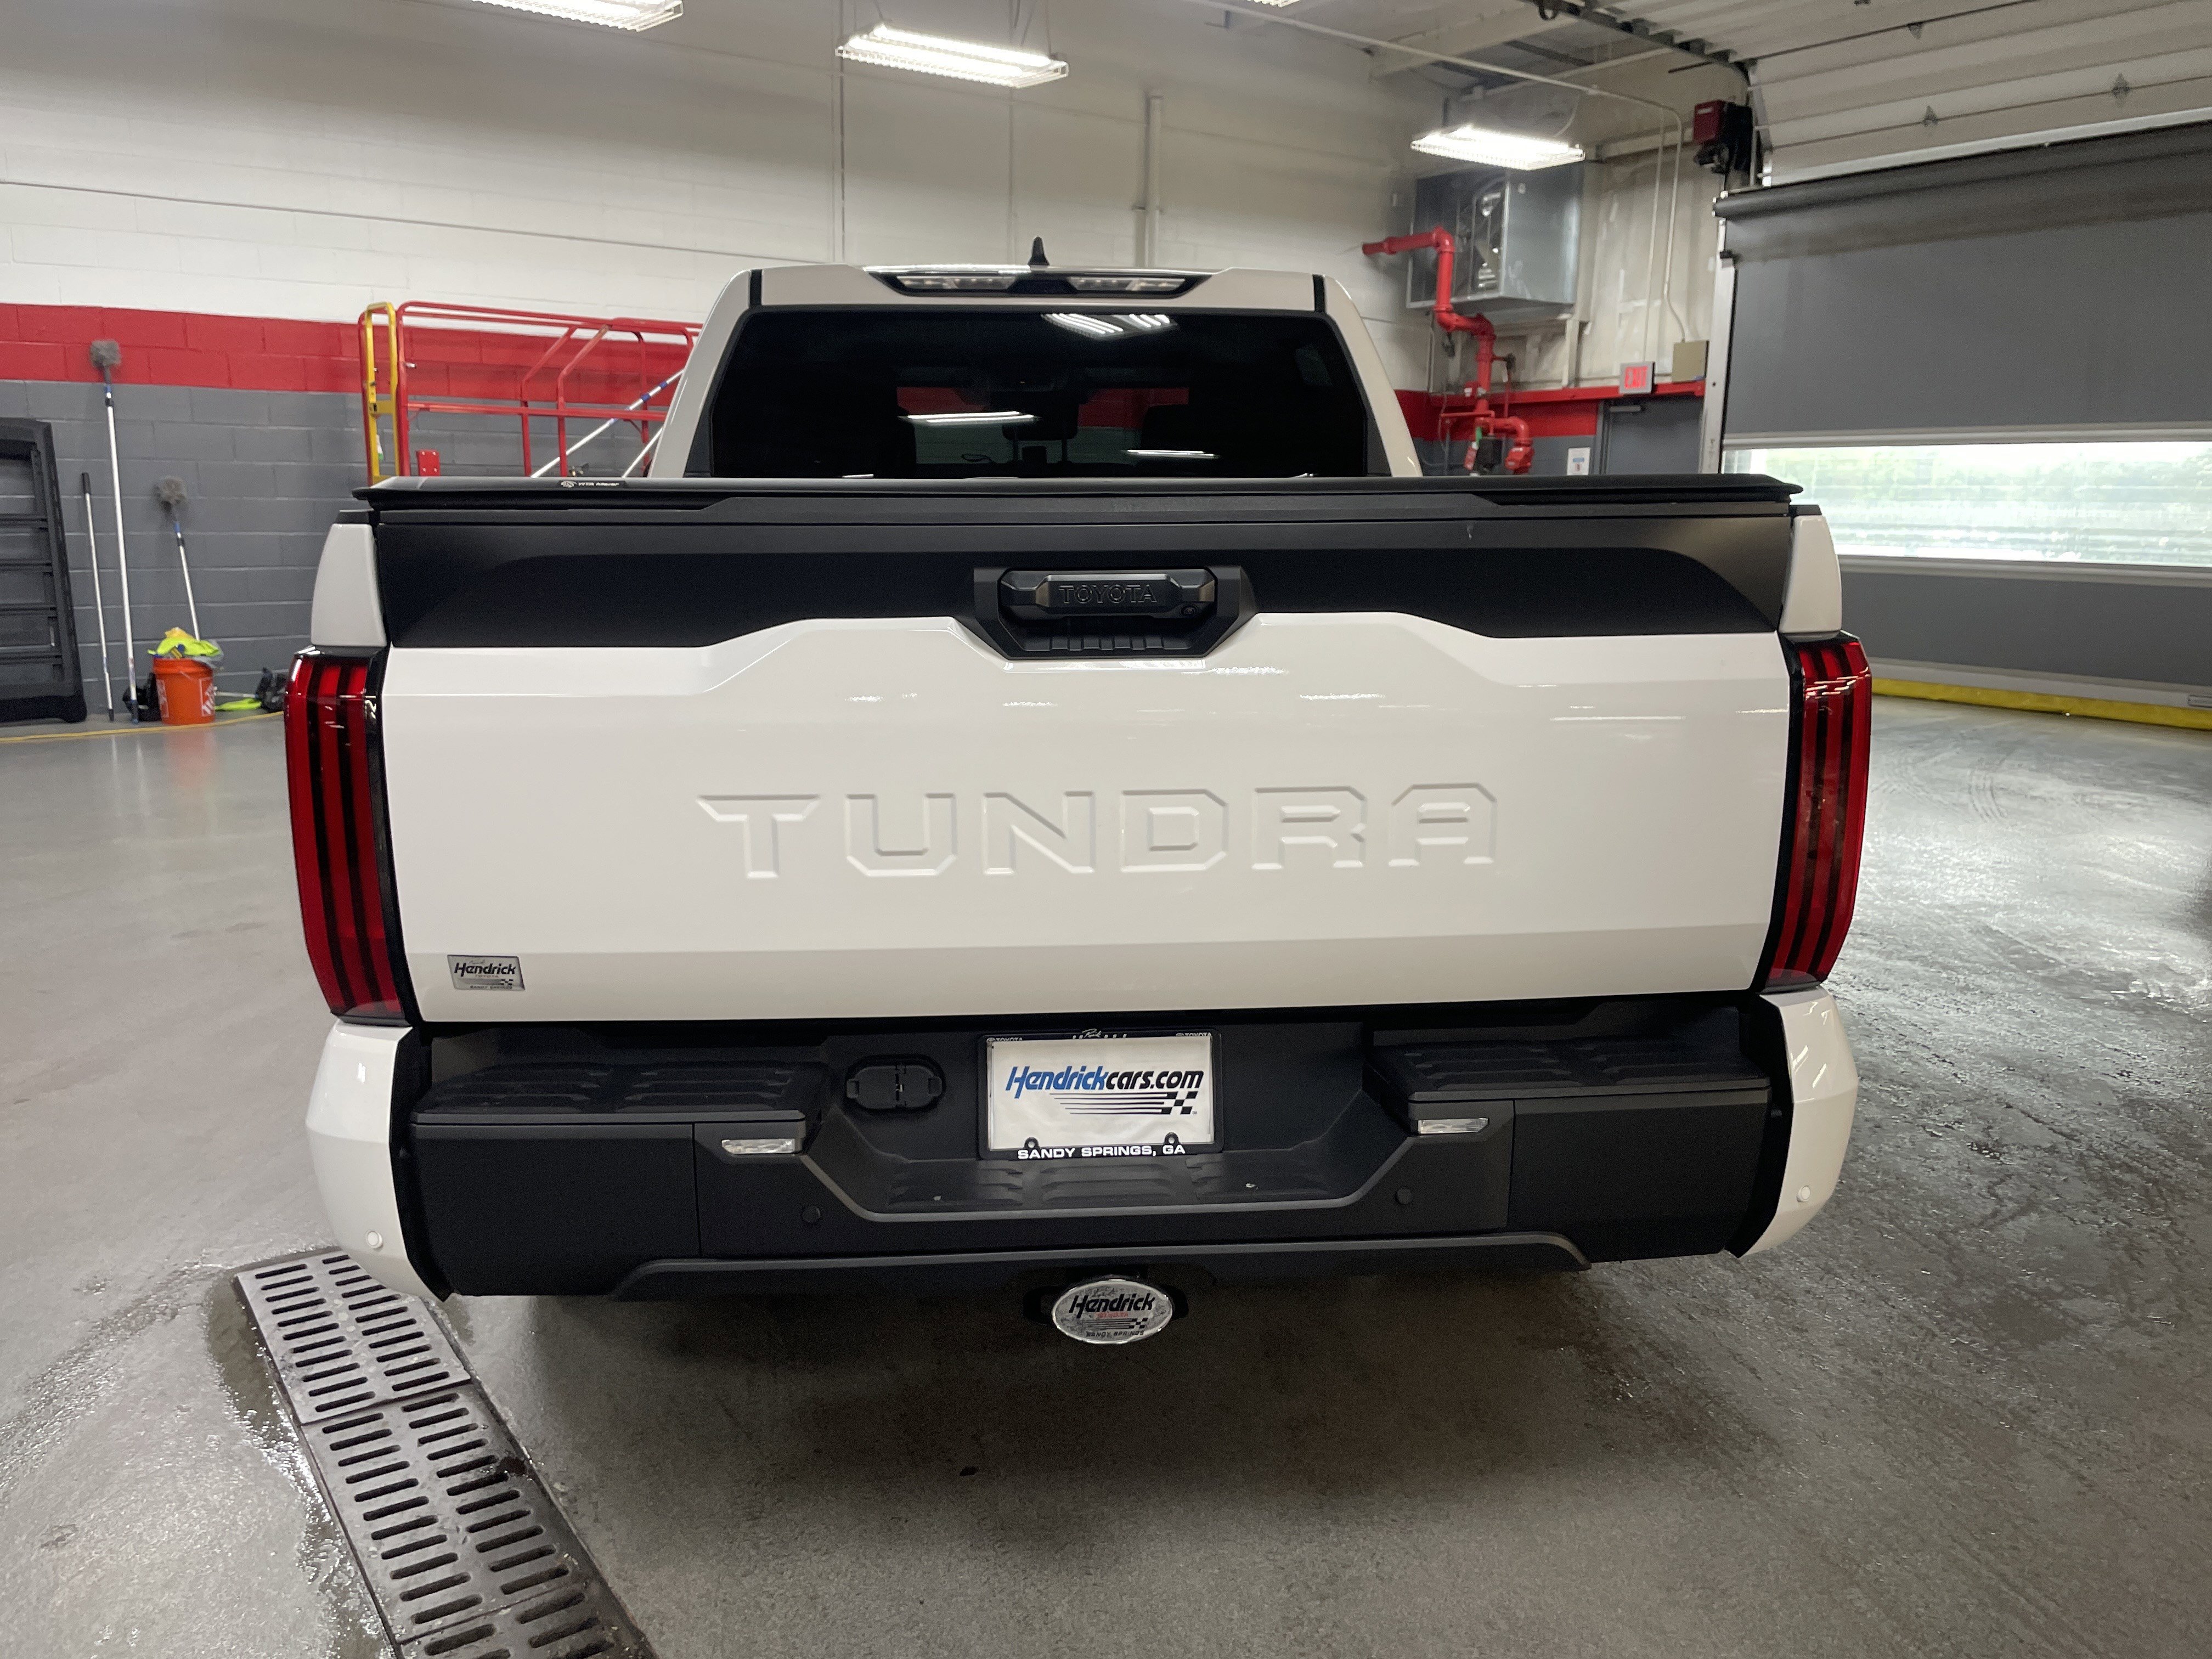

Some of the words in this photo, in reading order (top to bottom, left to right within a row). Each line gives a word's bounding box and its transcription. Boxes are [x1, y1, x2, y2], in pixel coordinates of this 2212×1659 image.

[1624, 366, 1647, 389] EXIT
[1058, 584, 1158, 604] TOYOTA
[696, 782, 1497, 878] TUNDRA
[454, 962, 516, 977] Hendrick
[1005, 1065, 1204, 1099] Hendrickcars.com
[1017, 1148, 1075, 1160] SANDY
[1081, 1146, 1156, 1157] SPRINGS,
[1162, 1144, 1186, 1155] GA
[1069, 1293, 1156, 1319] Hendrick
